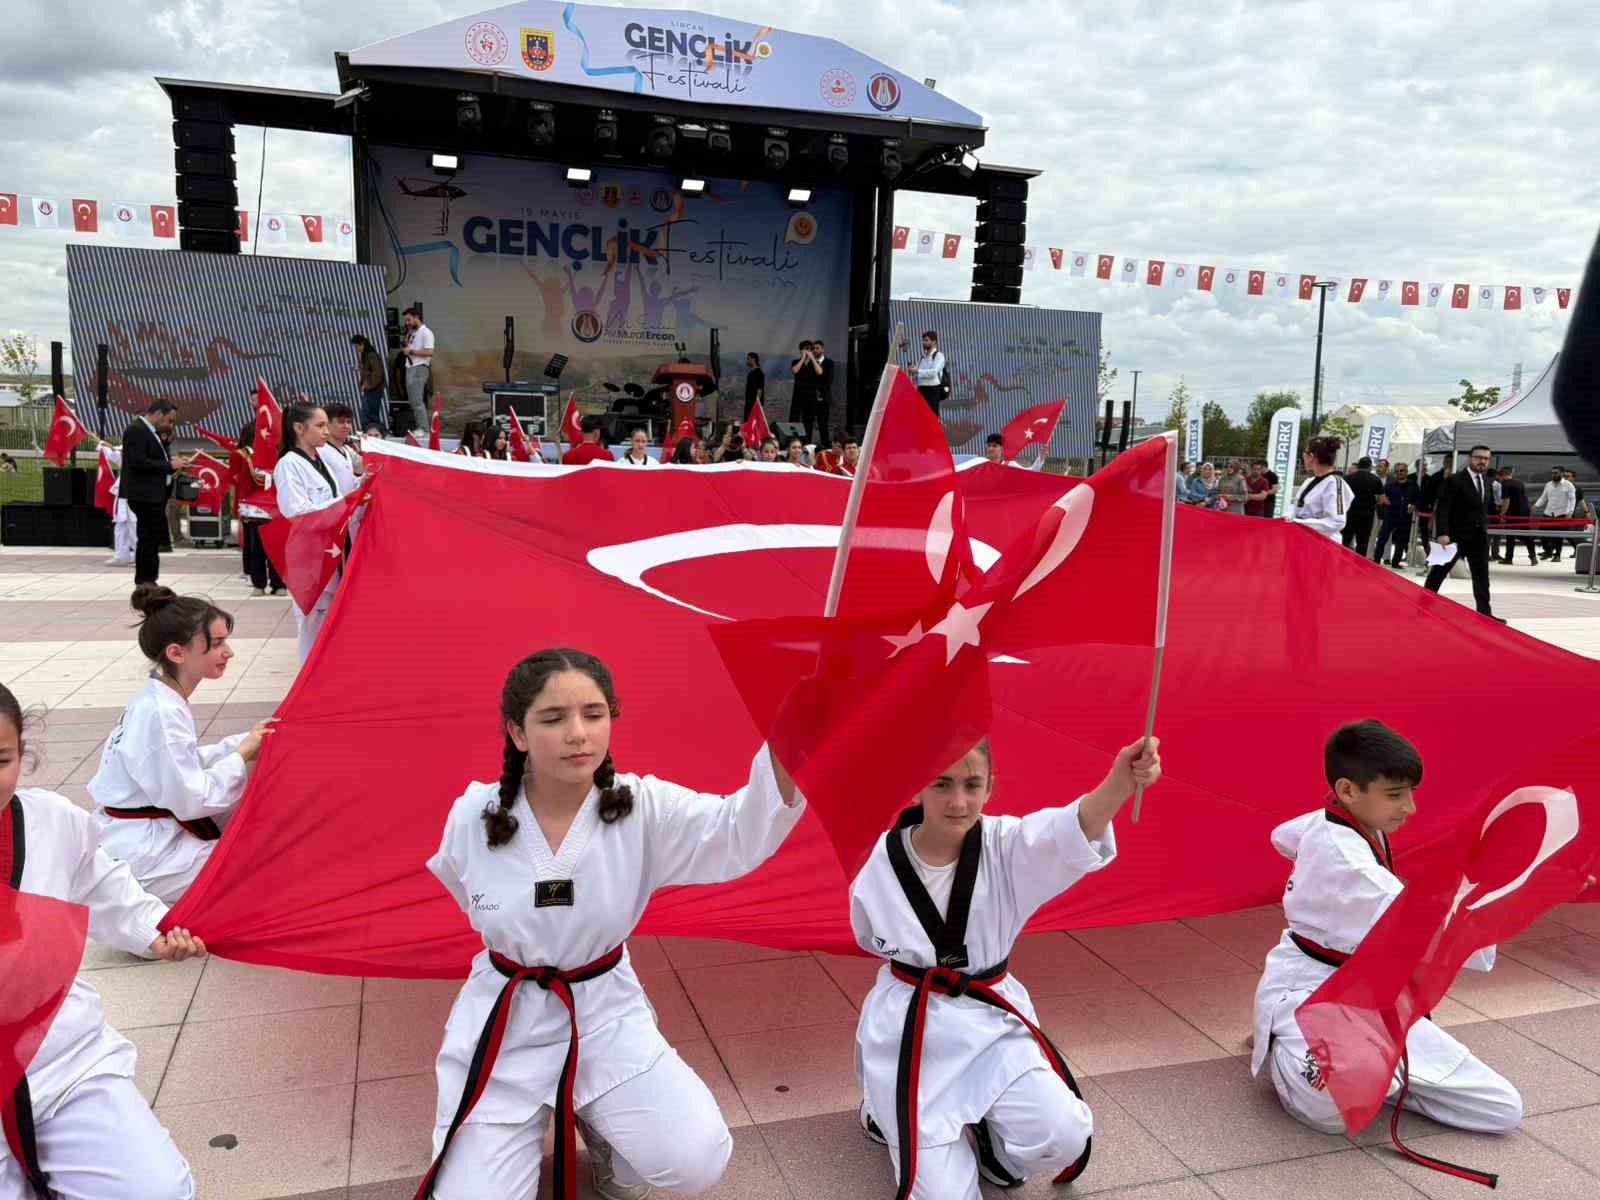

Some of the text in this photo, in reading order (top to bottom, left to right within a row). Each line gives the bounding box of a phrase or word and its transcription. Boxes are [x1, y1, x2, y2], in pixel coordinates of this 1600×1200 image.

[624, 22, 753, 66] GENÇLİK
[636, 53, 747, 97] Festivali
[520, 207, 583, 220] 19 MAYIS
[463, 216, 799, 280] GENÇLİK Festivali
[646, 331, 676, 341] Ercan
[1277, 423, 1292, 461] PARK
